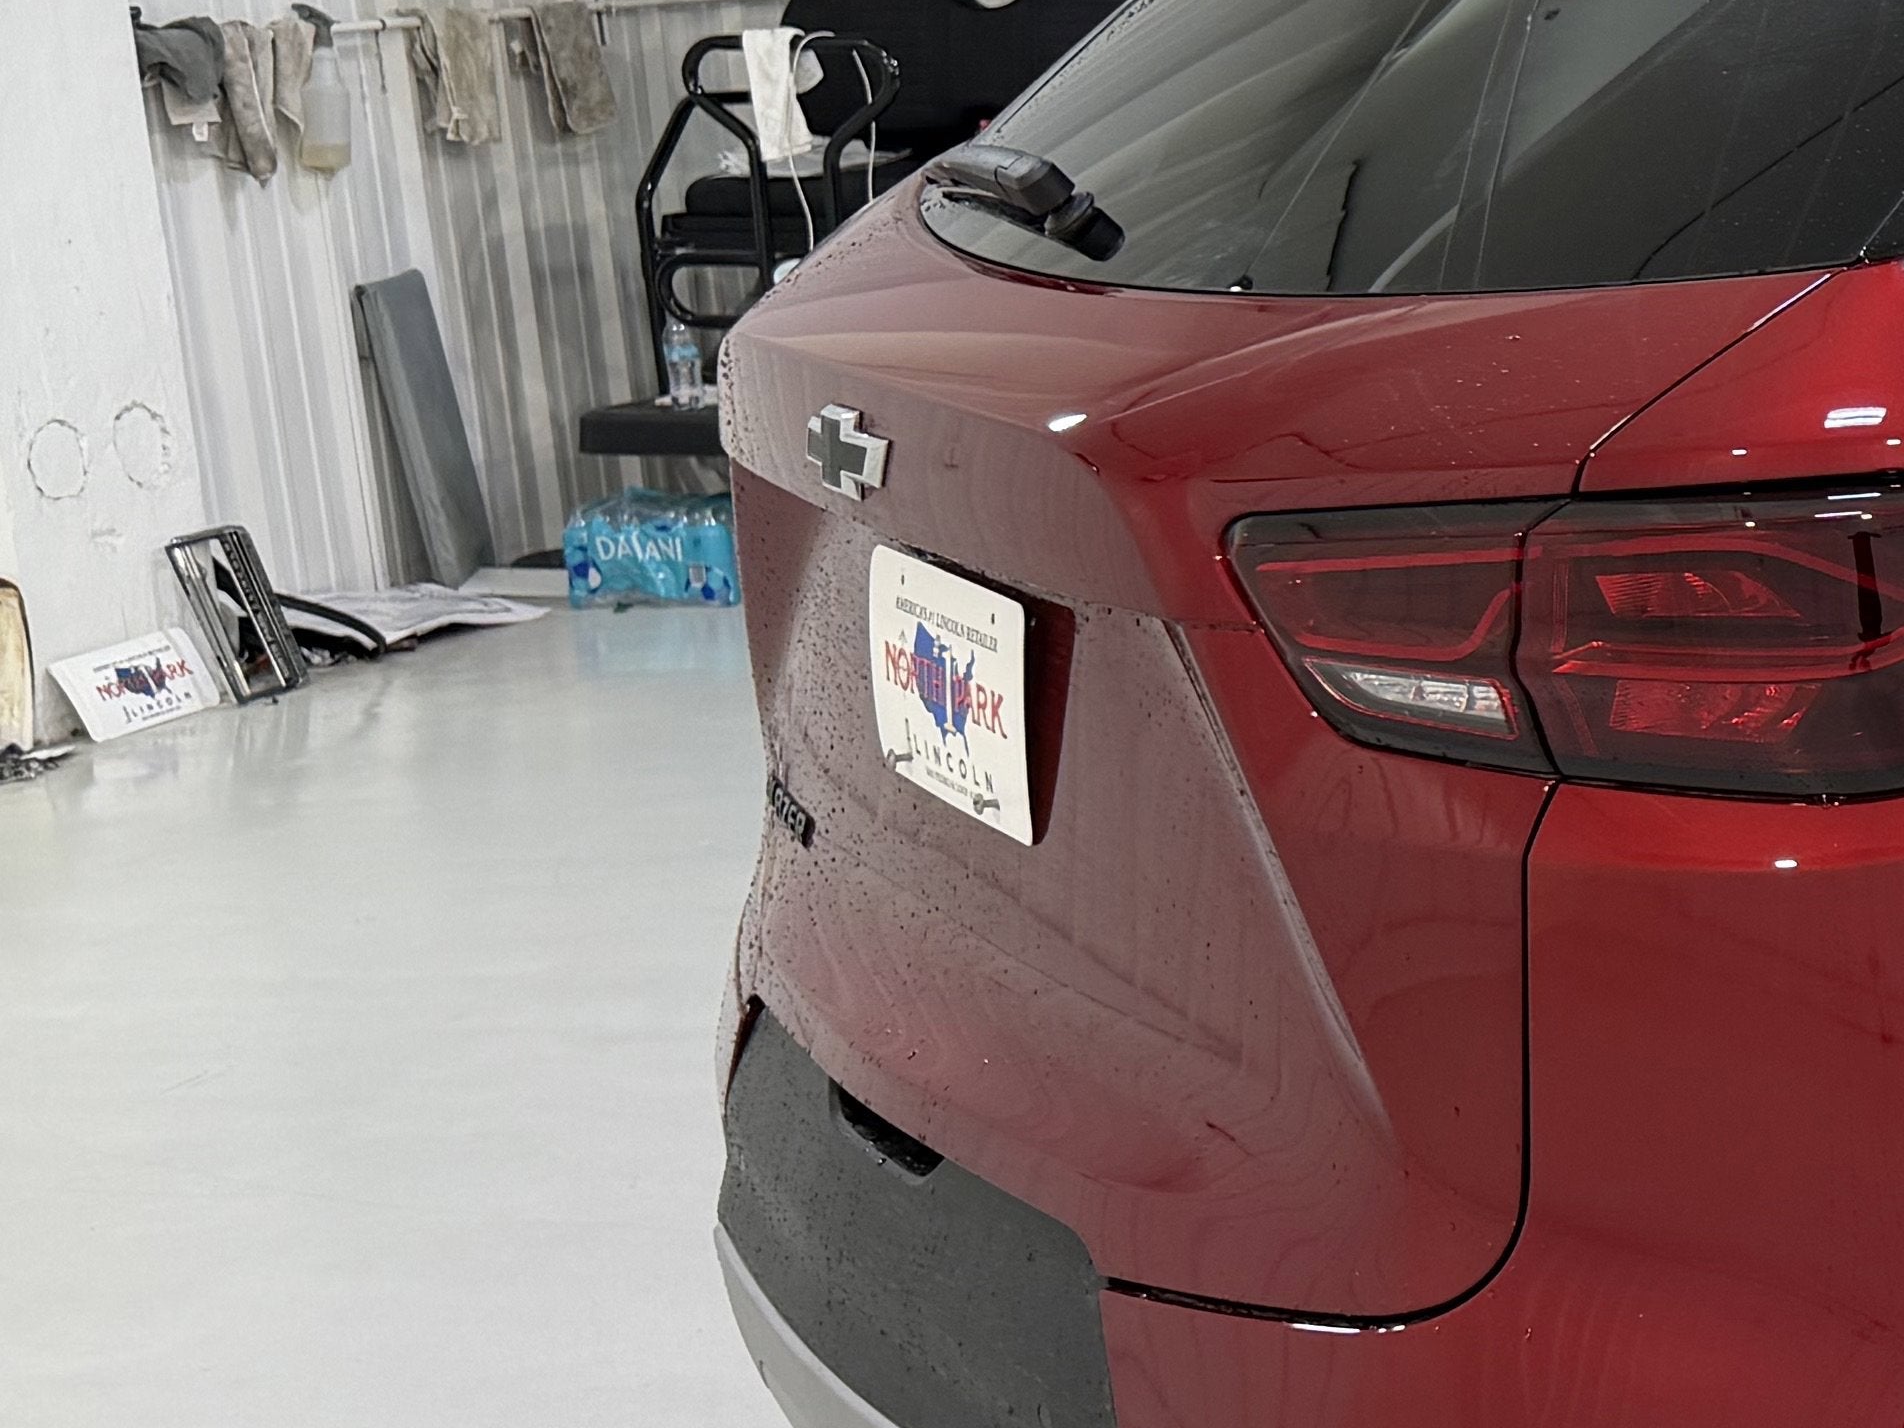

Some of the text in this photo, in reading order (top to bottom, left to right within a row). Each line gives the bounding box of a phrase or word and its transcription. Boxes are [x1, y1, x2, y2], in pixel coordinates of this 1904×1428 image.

[595, 529, 683, 563] DASANI
[885, 640, 1007, 740] NORTH PARK
[913, 733, 994, 794] LINCOLN
